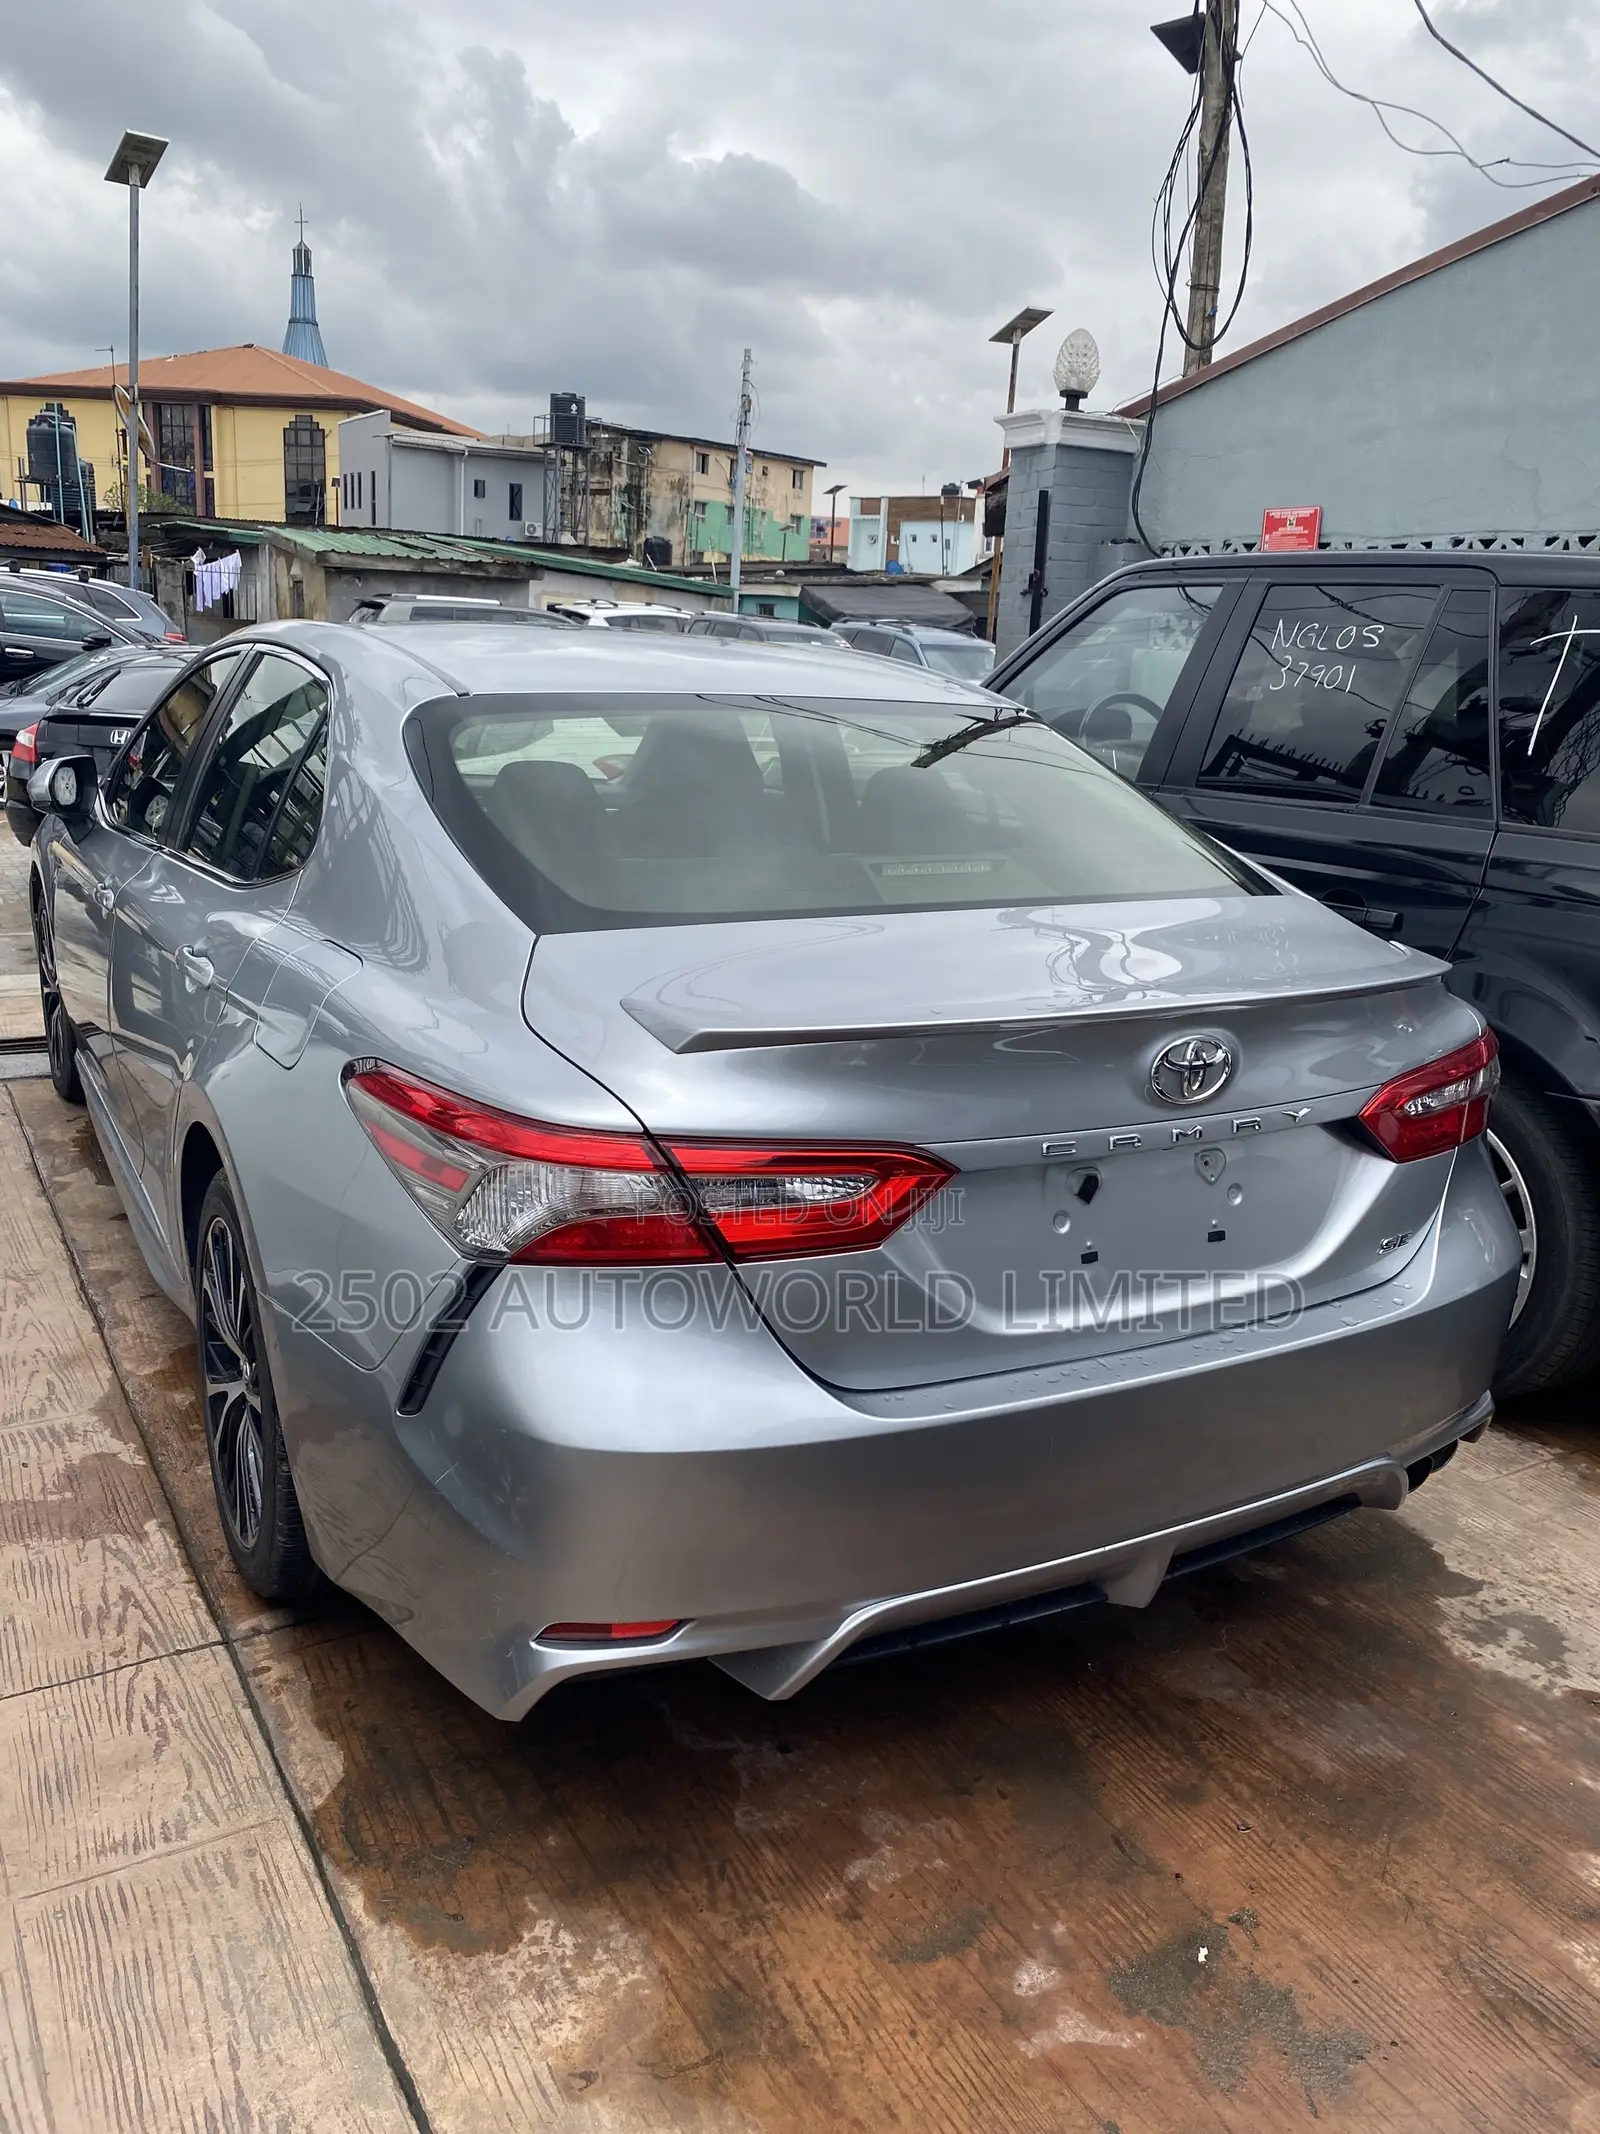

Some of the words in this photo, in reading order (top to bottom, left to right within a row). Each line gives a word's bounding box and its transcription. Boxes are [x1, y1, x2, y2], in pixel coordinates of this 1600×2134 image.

[1269, 655, 1357, 693] 37901
[1041, 1107, 1312, 1157] CAMRY
[1377, 1232, 1412, 1255] SE
